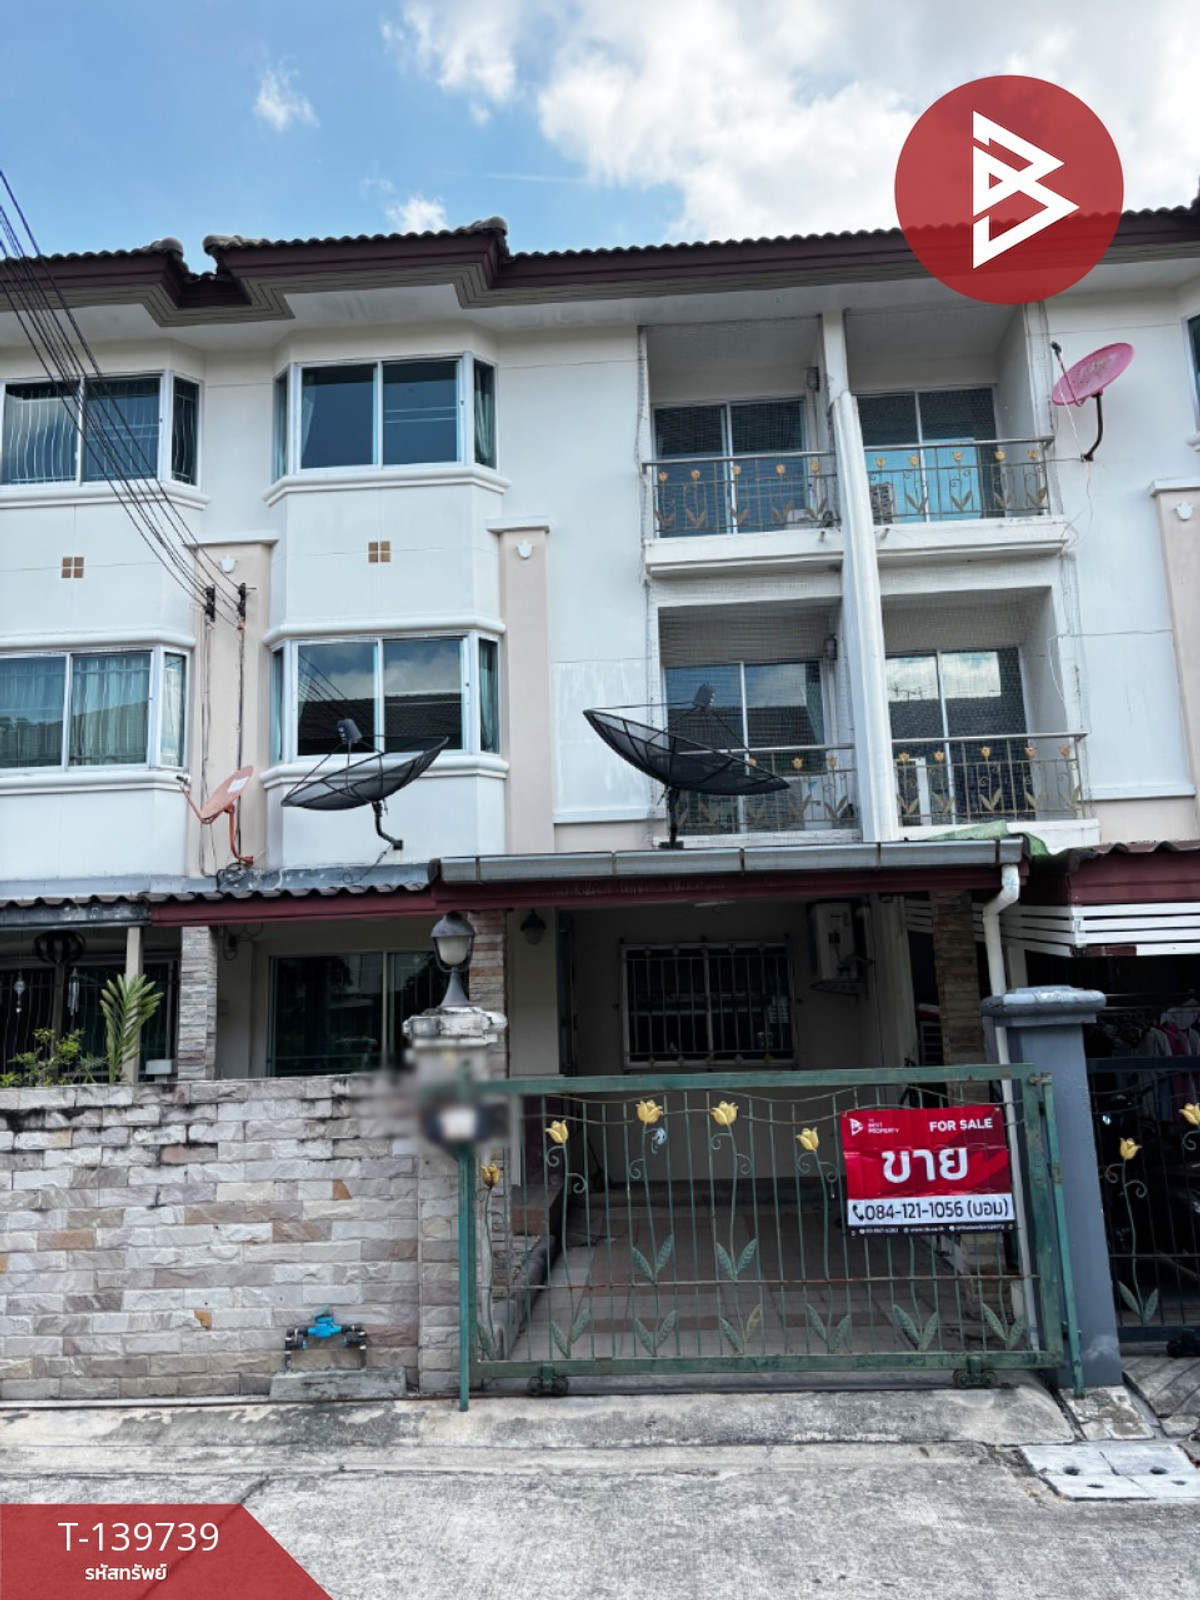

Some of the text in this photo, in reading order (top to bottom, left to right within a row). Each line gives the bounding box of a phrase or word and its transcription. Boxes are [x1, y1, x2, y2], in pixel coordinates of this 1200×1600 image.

[929, 1118, 993, 1132] FOR SALE
[881, 1147, 969, 1184] ขาย
[865, 1199, 1009, 1221] 084-121-1056 (บอม)
